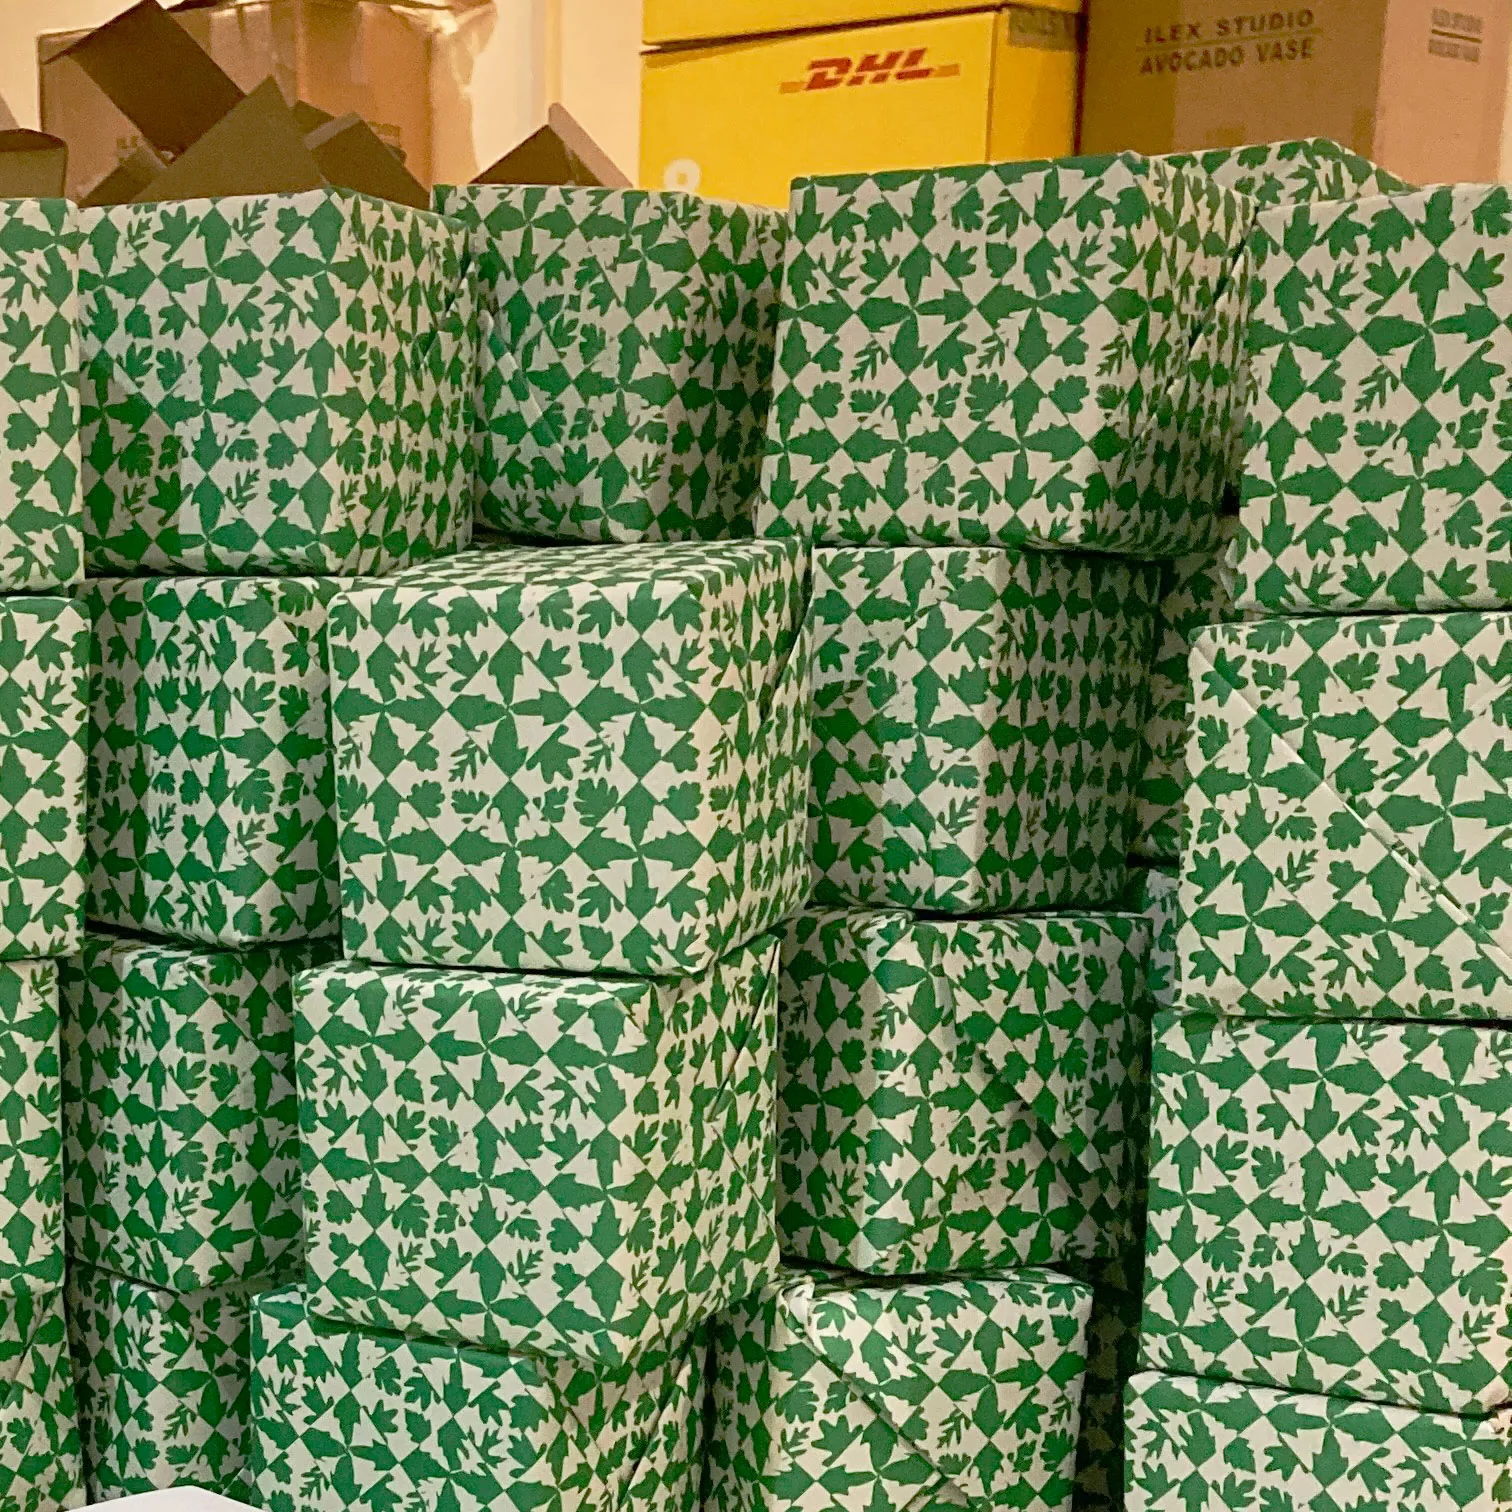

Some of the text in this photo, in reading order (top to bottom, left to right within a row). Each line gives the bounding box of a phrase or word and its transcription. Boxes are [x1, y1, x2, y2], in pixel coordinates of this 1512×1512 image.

[1144, 9, 1314, 45] ILEX STUDIO
[804, 47, 936, 91] DHL
[1140, 36, 1314, 75] AVOCADO VASE
